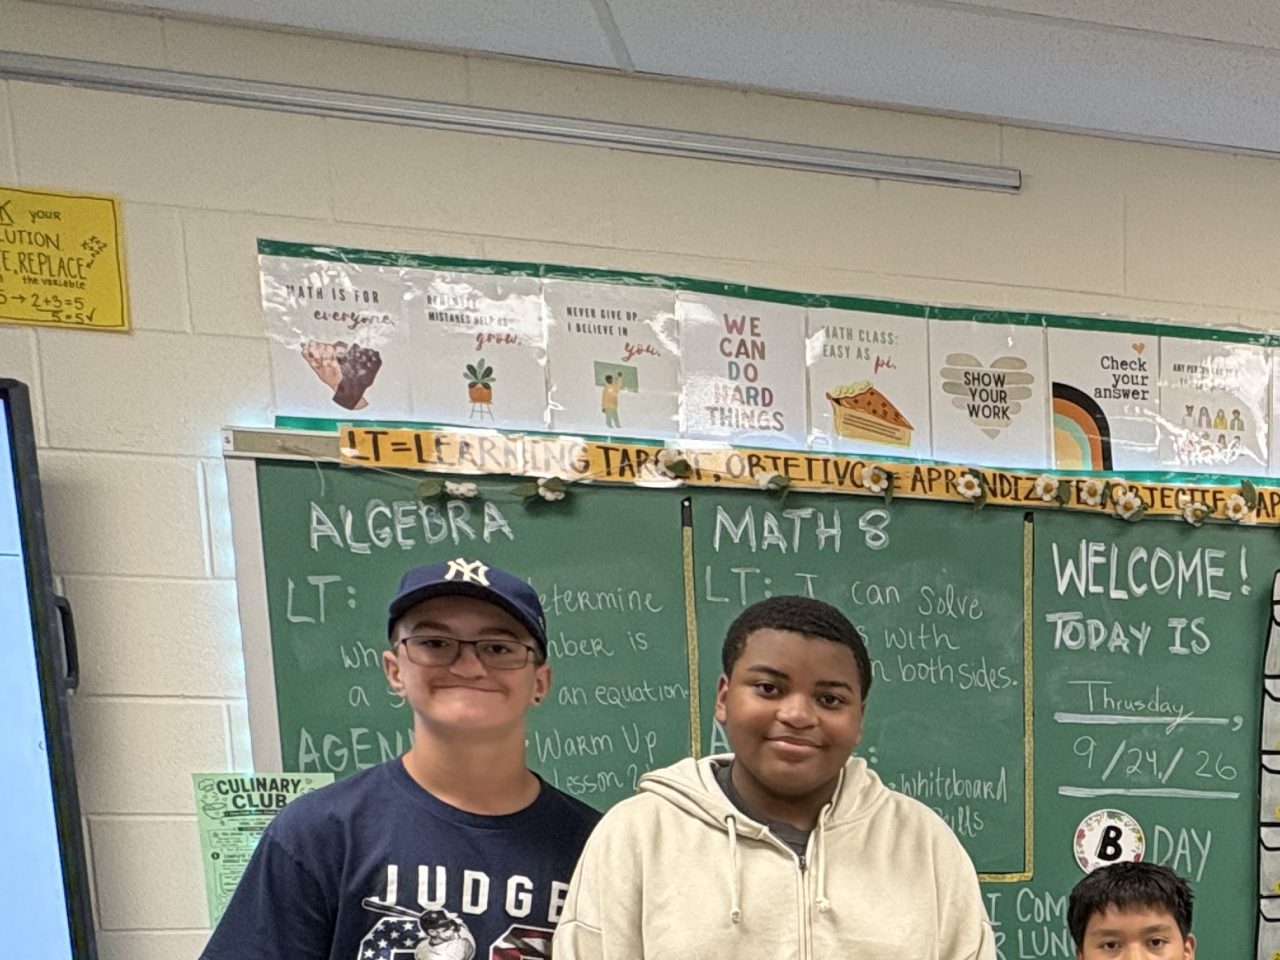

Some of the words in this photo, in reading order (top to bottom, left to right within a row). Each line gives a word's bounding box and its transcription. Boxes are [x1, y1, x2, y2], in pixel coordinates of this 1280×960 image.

[0, 229, 61, 251] UTION
[331, 286, 346, 301] IS
[354, 289, 380, 305] FOR
[428, 310, 472, 325] MISTAKES
[566, 305, 594, 320] NEVER
[599, 307, 622, 321] GIVE
[566, 322, 573, 333] I
[576, 323, 613, 336] BELIEVE
[615, 325, 629, 336] IN
[723, 313, 762, 337] WE
[719, 337, 766, 361] CAN
[822, 344, 850, 359] EASY
[856, 347, 871, 361] AS
[727, 360, 759, 384] DO
[1100, 355, 1148, 373] Check
[963, 371, 1006, 388] SHOW
[1111, 373, 1149, 389] your
[714, 383, 773, 408] HARD
[968, 387, 1008, 404] YOUR
[1094, 386, 1150, 401] answer
[704, 405, 785, 432] THINGS
[967, 403, 1010, 421] WORK
[309, 498, 515, 554] ALGEBRA
[712, 504, 842, 553] MATH
[857, 507, 891, 550] 8
[850, 579, 902, 607] can
[627, 631, 648, 653] is
[1045, 611, 1152, 657] TODAY
[1167, 616, 1212, 656] IS
[897, 654, 955, 685] both
[348, 685, 369, 708] a
[558, 684, 588, 707] an
[622, 722, 658, 763] Up
[216, 777, 302, 796] CULINARY
[232, 793, 288, 809] CLUB
[1096, 824, 1123, 862] B
[1151, 824, 1212, 883] DAY
[373, 864, 570, 923] JUDGE
